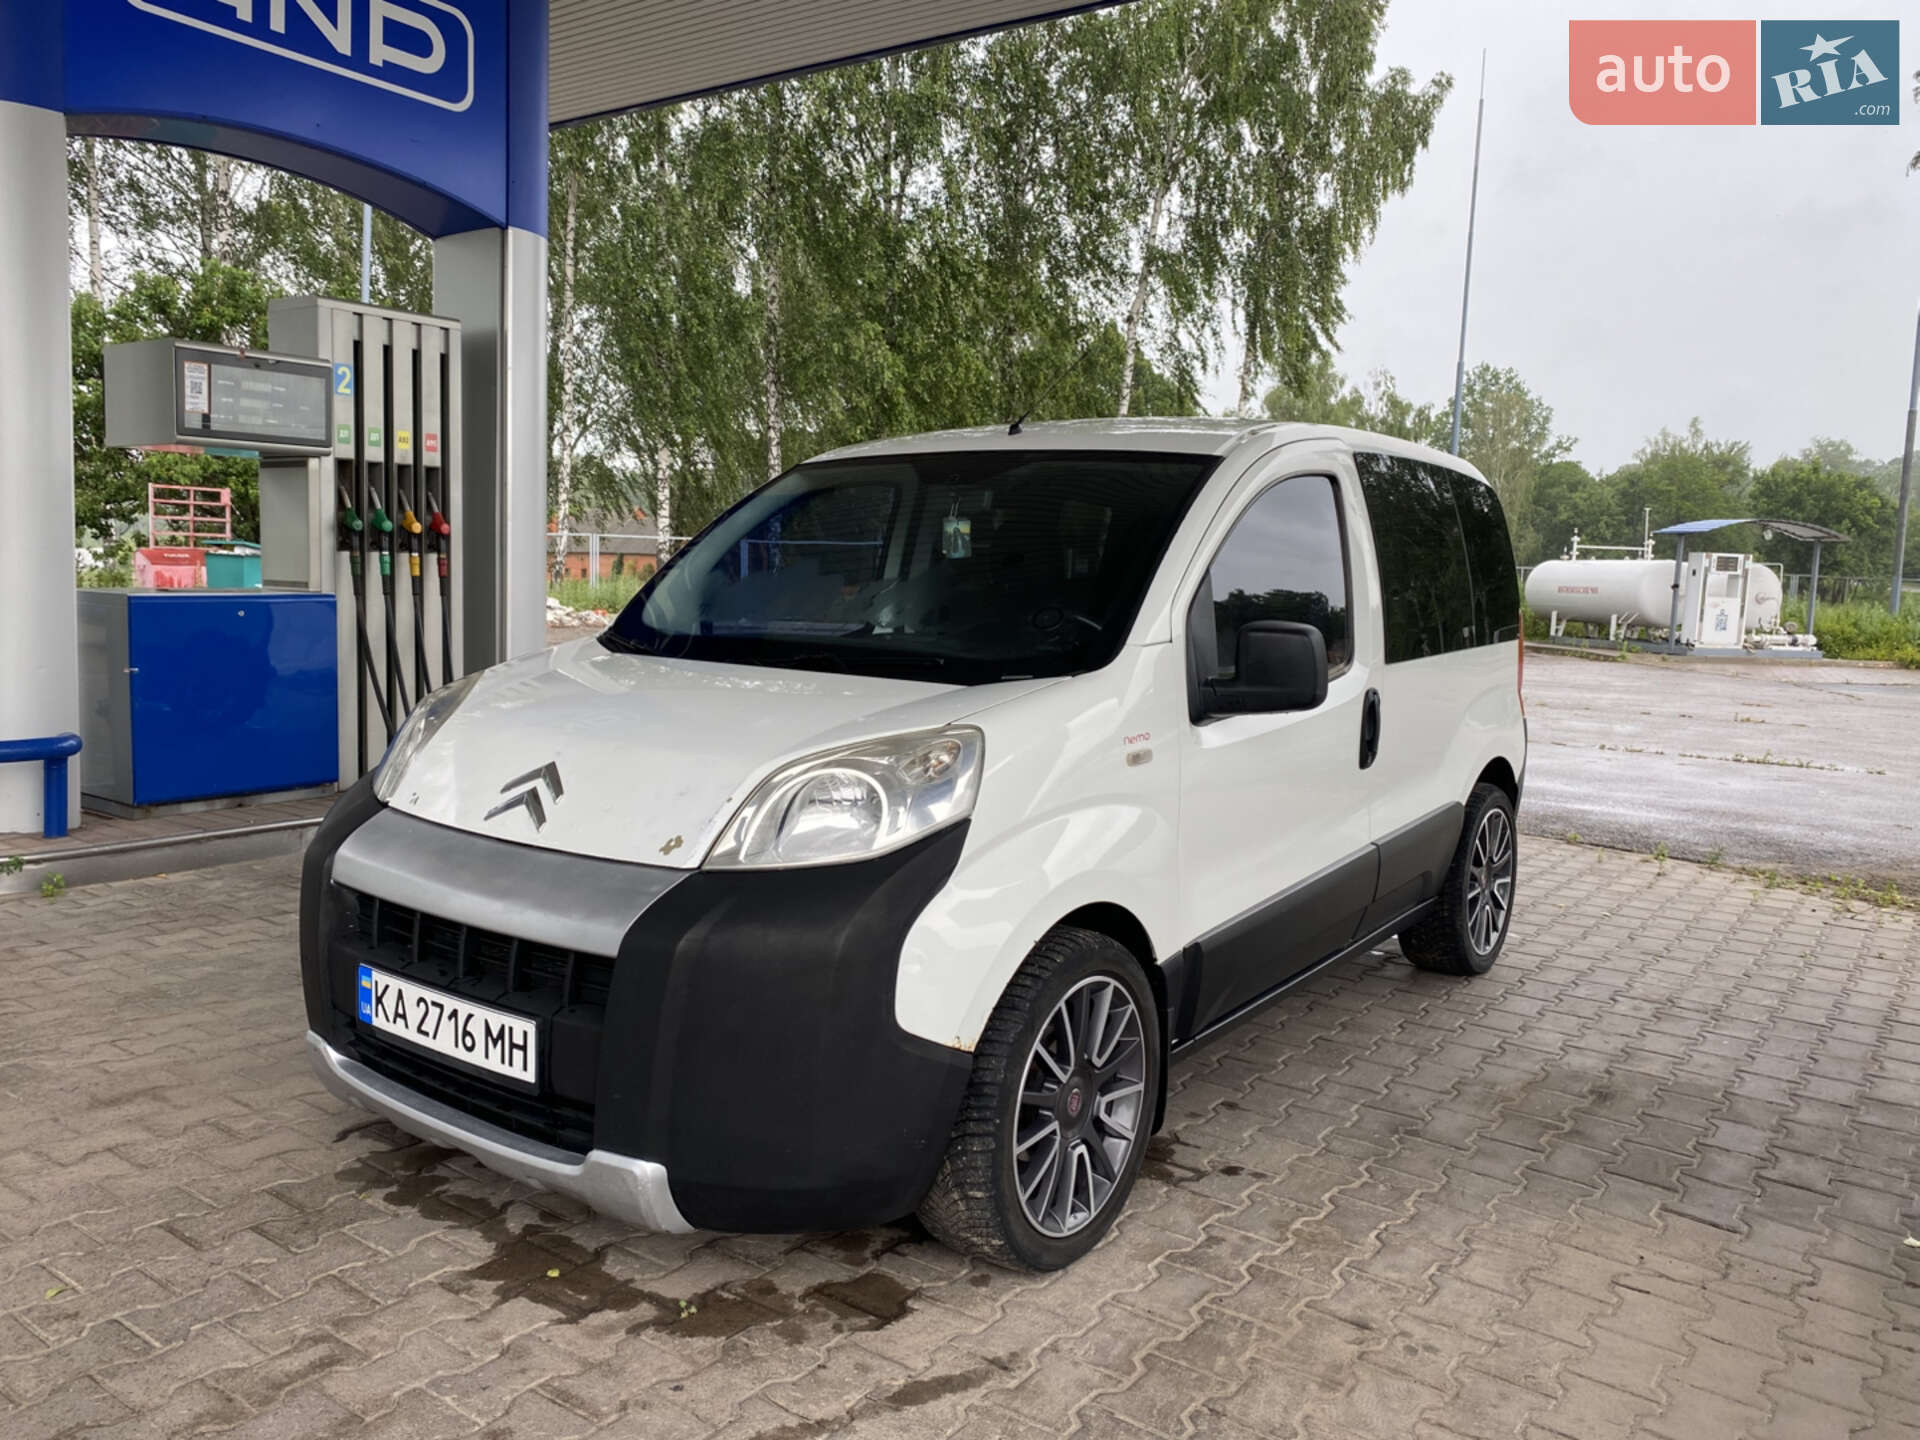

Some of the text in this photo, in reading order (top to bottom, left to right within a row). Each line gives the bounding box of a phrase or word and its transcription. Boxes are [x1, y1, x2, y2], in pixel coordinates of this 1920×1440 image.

[337, 366, 351, 394] 2
[1123, 731, 1151, 745] nemo
[360, 1001, 372, 1016] UA
[374, 980, 528, 1072] KA 2716 MH
